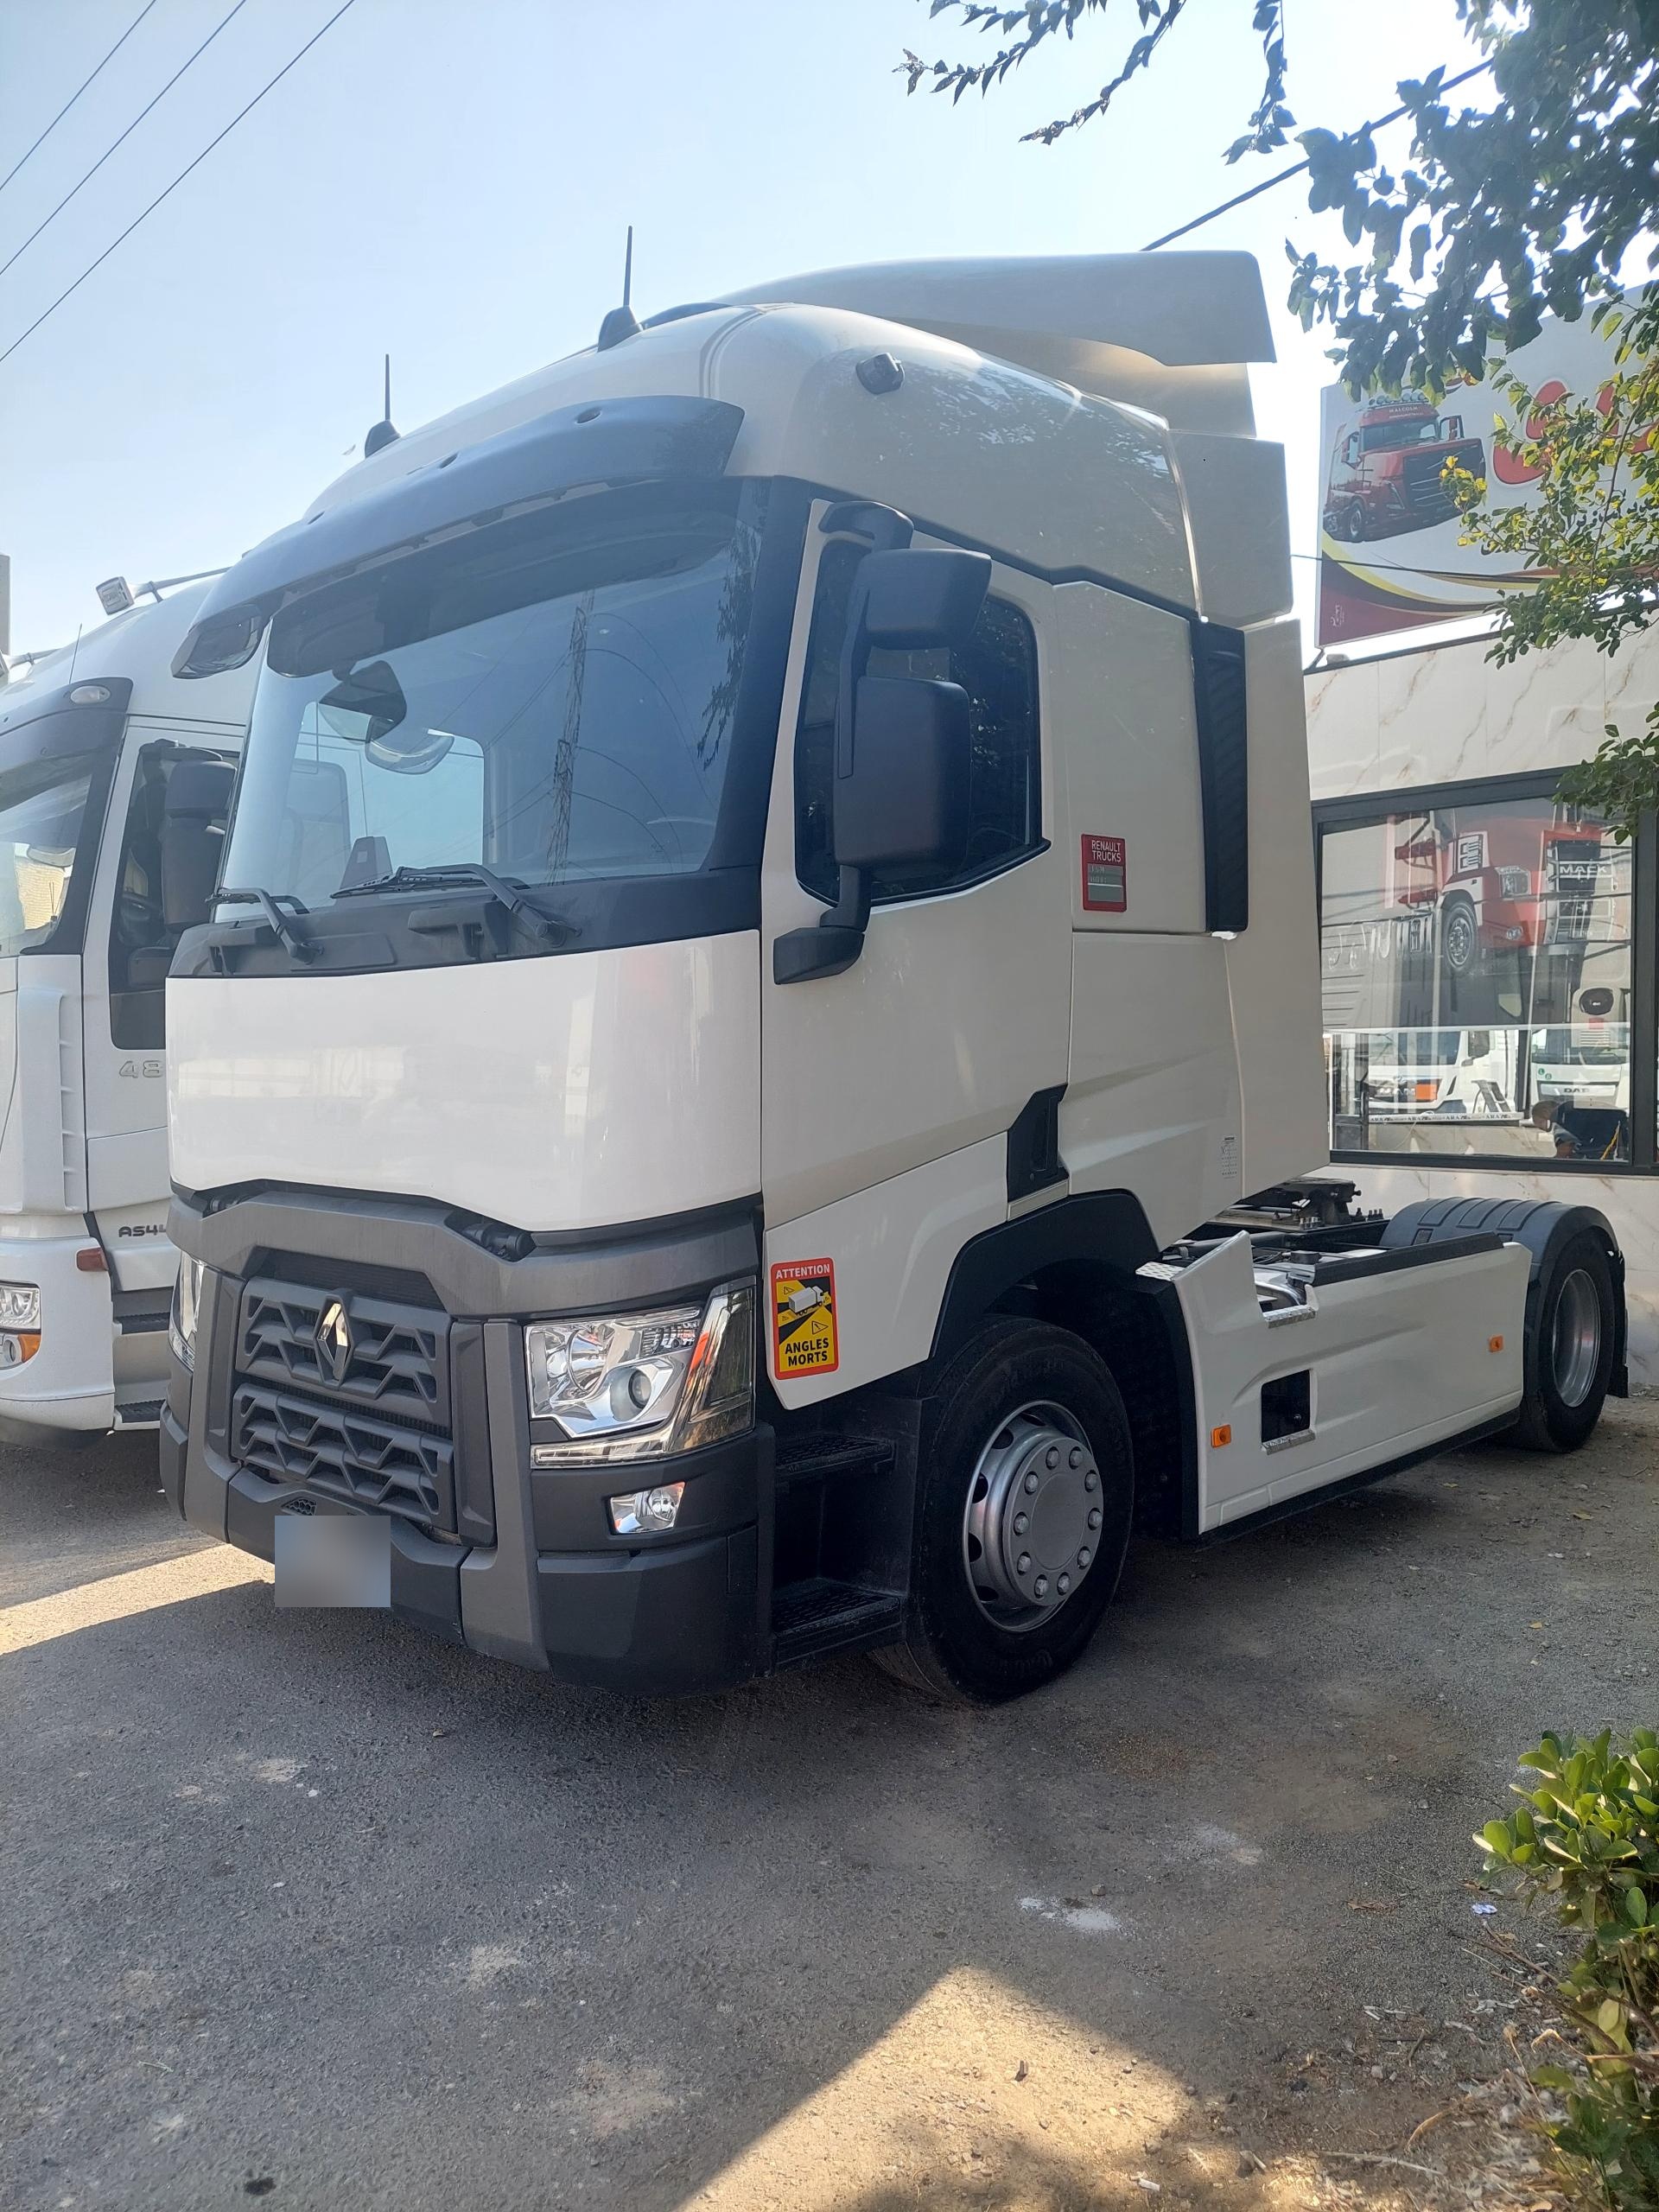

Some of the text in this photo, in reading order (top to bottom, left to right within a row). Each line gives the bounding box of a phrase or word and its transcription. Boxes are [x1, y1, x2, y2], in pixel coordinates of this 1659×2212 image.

[1091, 839, 1122, 853] RENAULT
[1092, 849, 1122, 862] TRUCKS
[776, 1263, 830, 1280] ATTENTION
[785, 1338, 830, 1355] ANGLES
[787, 1351, 829, 1367] MORTS
